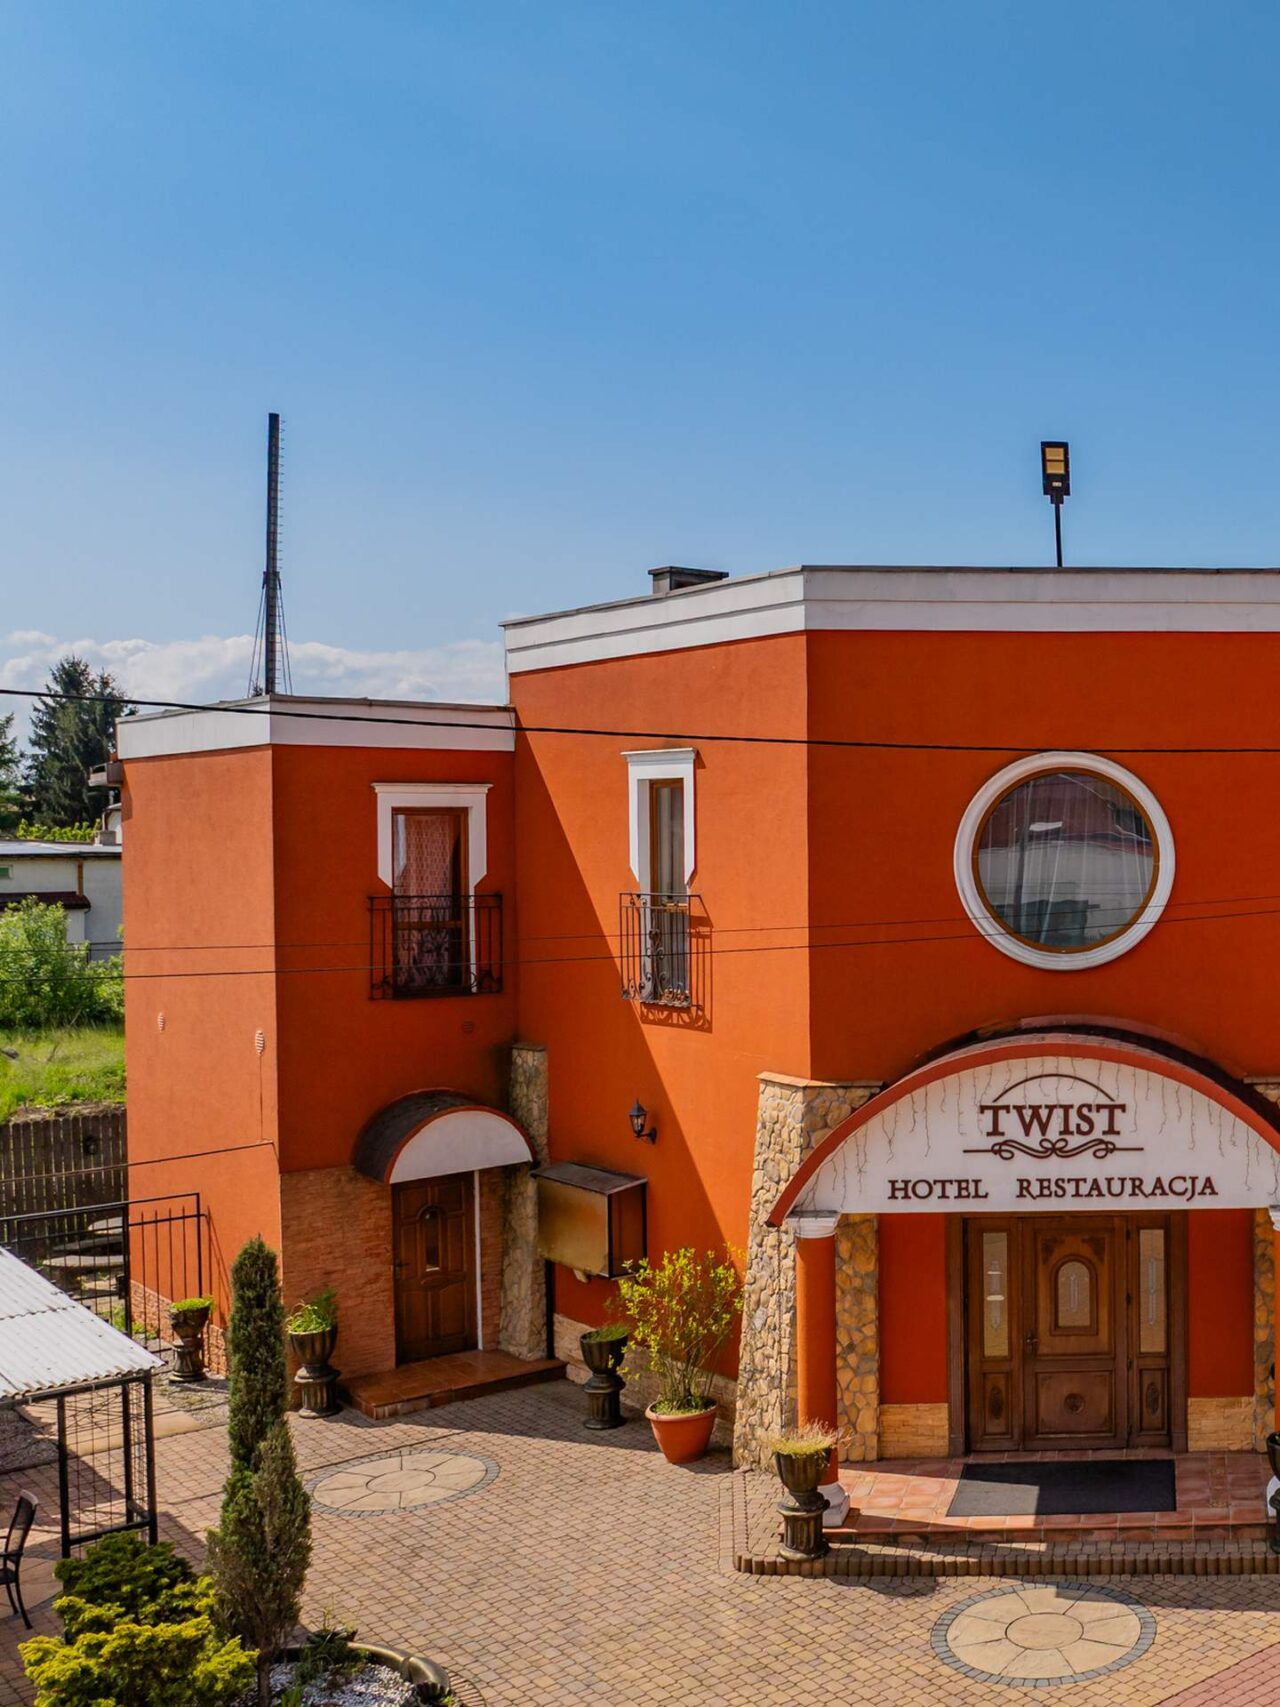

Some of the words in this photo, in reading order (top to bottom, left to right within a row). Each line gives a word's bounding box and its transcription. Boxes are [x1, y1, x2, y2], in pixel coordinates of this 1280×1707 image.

[979, 1104, 1126, 1137] TWIST
[887, 1178, 989, 1200] HOTEL
[1015, 1176, 1219, 1202] RESTAURACJA
